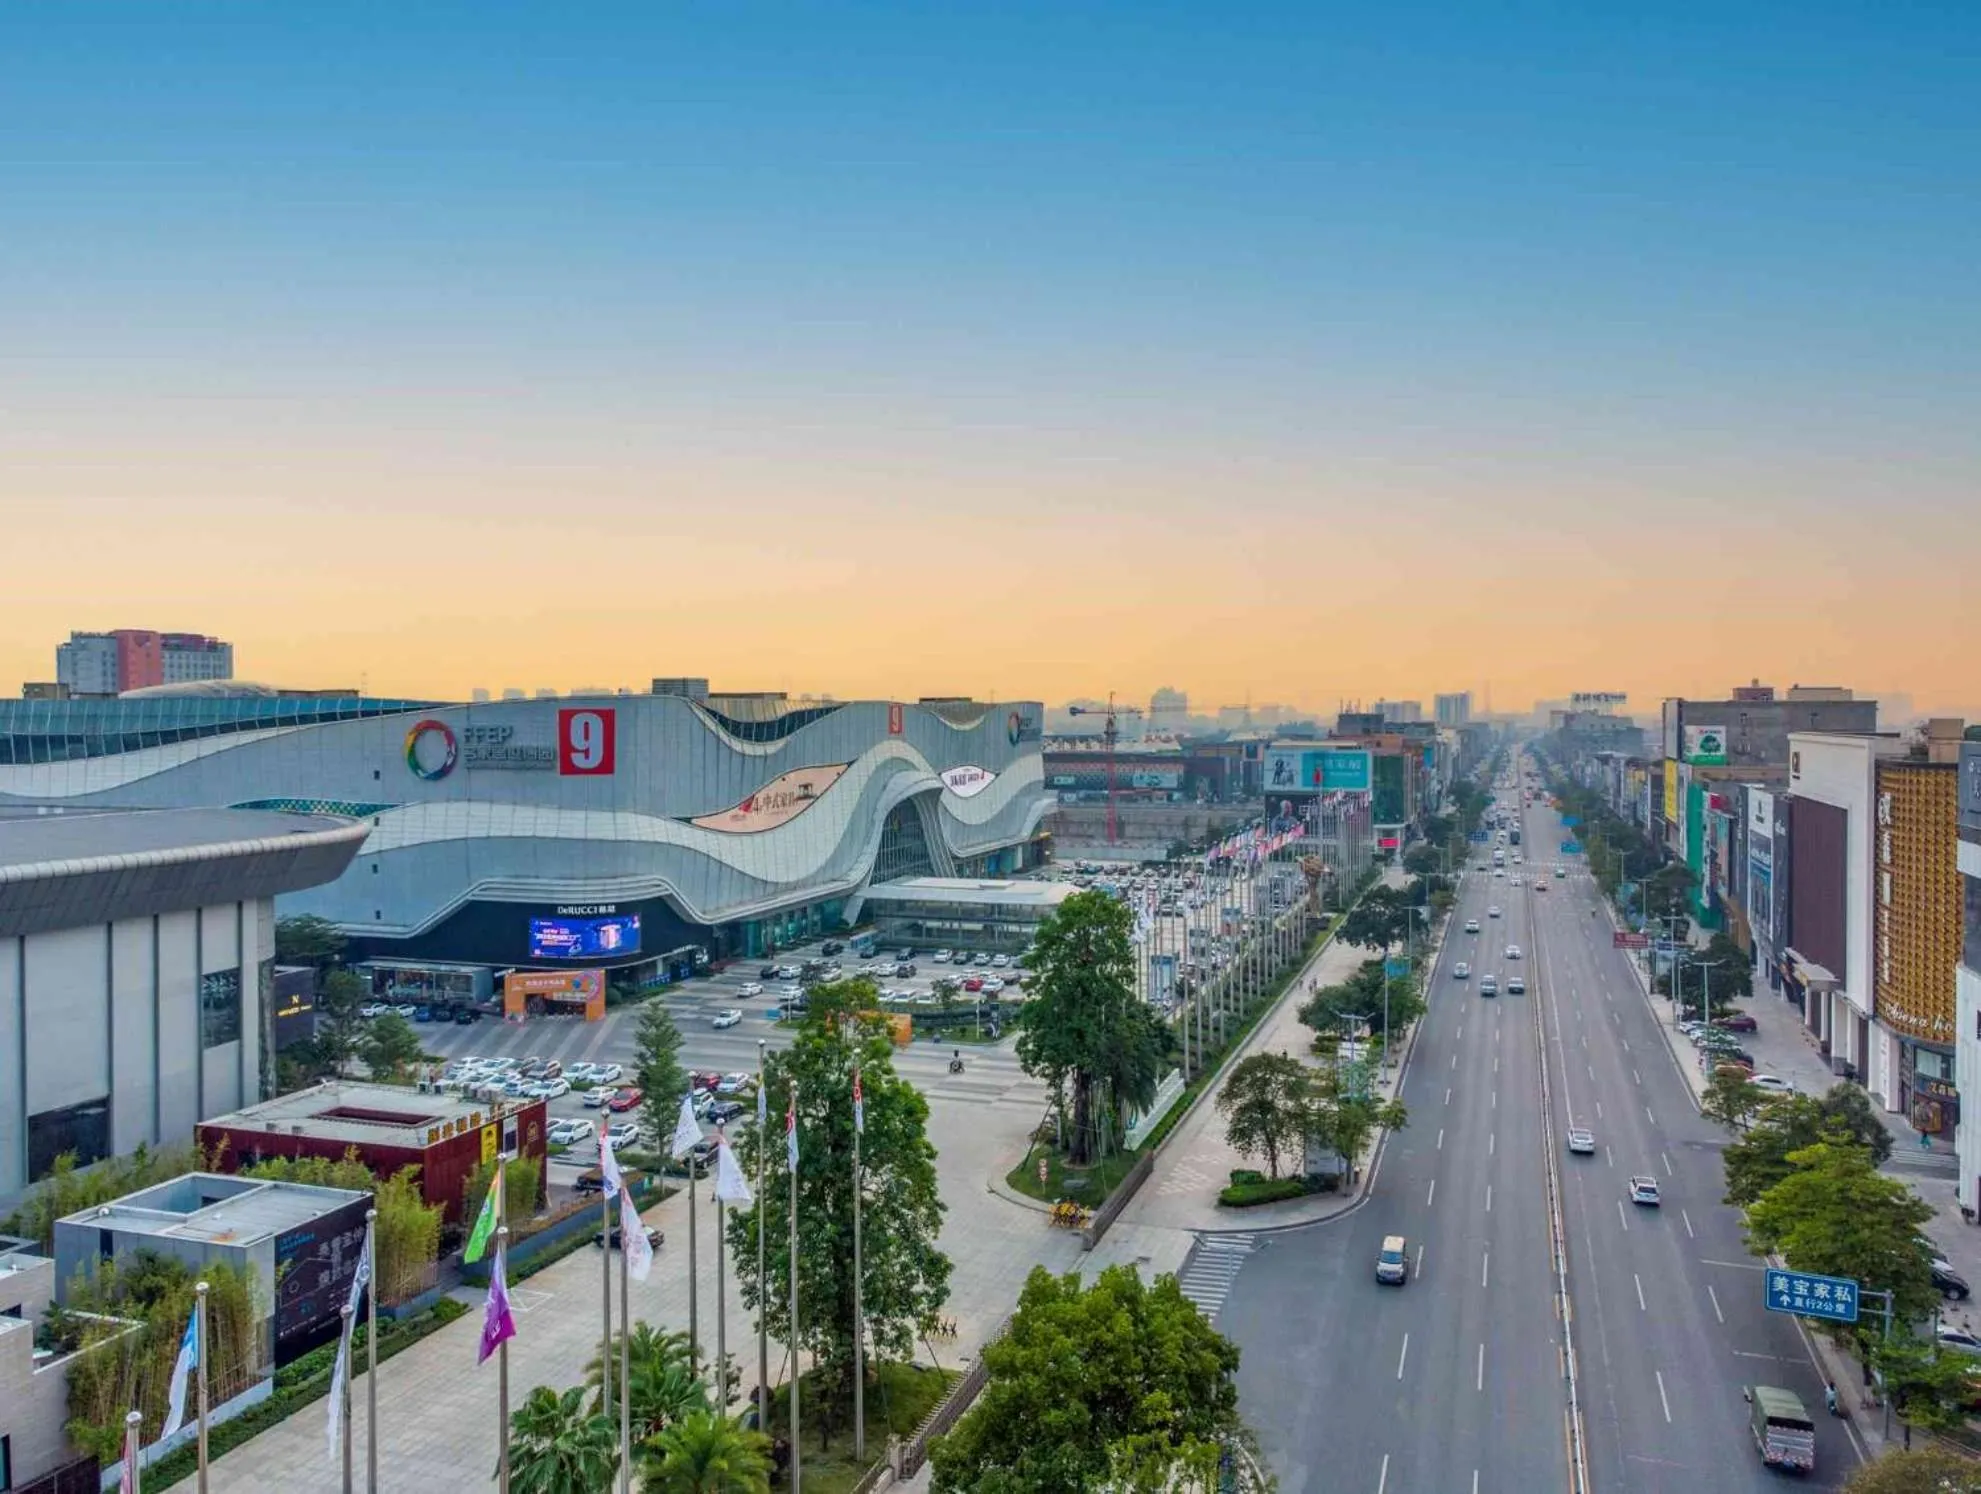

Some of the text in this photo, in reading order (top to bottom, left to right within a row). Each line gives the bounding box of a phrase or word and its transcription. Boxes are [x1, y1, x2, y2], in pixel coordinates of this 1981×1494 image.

[570, 711, 604, 769] 9
[1772, 1275, 1852, 1303] 美宝家私
[1793, 1296, 1846, 1314] 直行2公里
